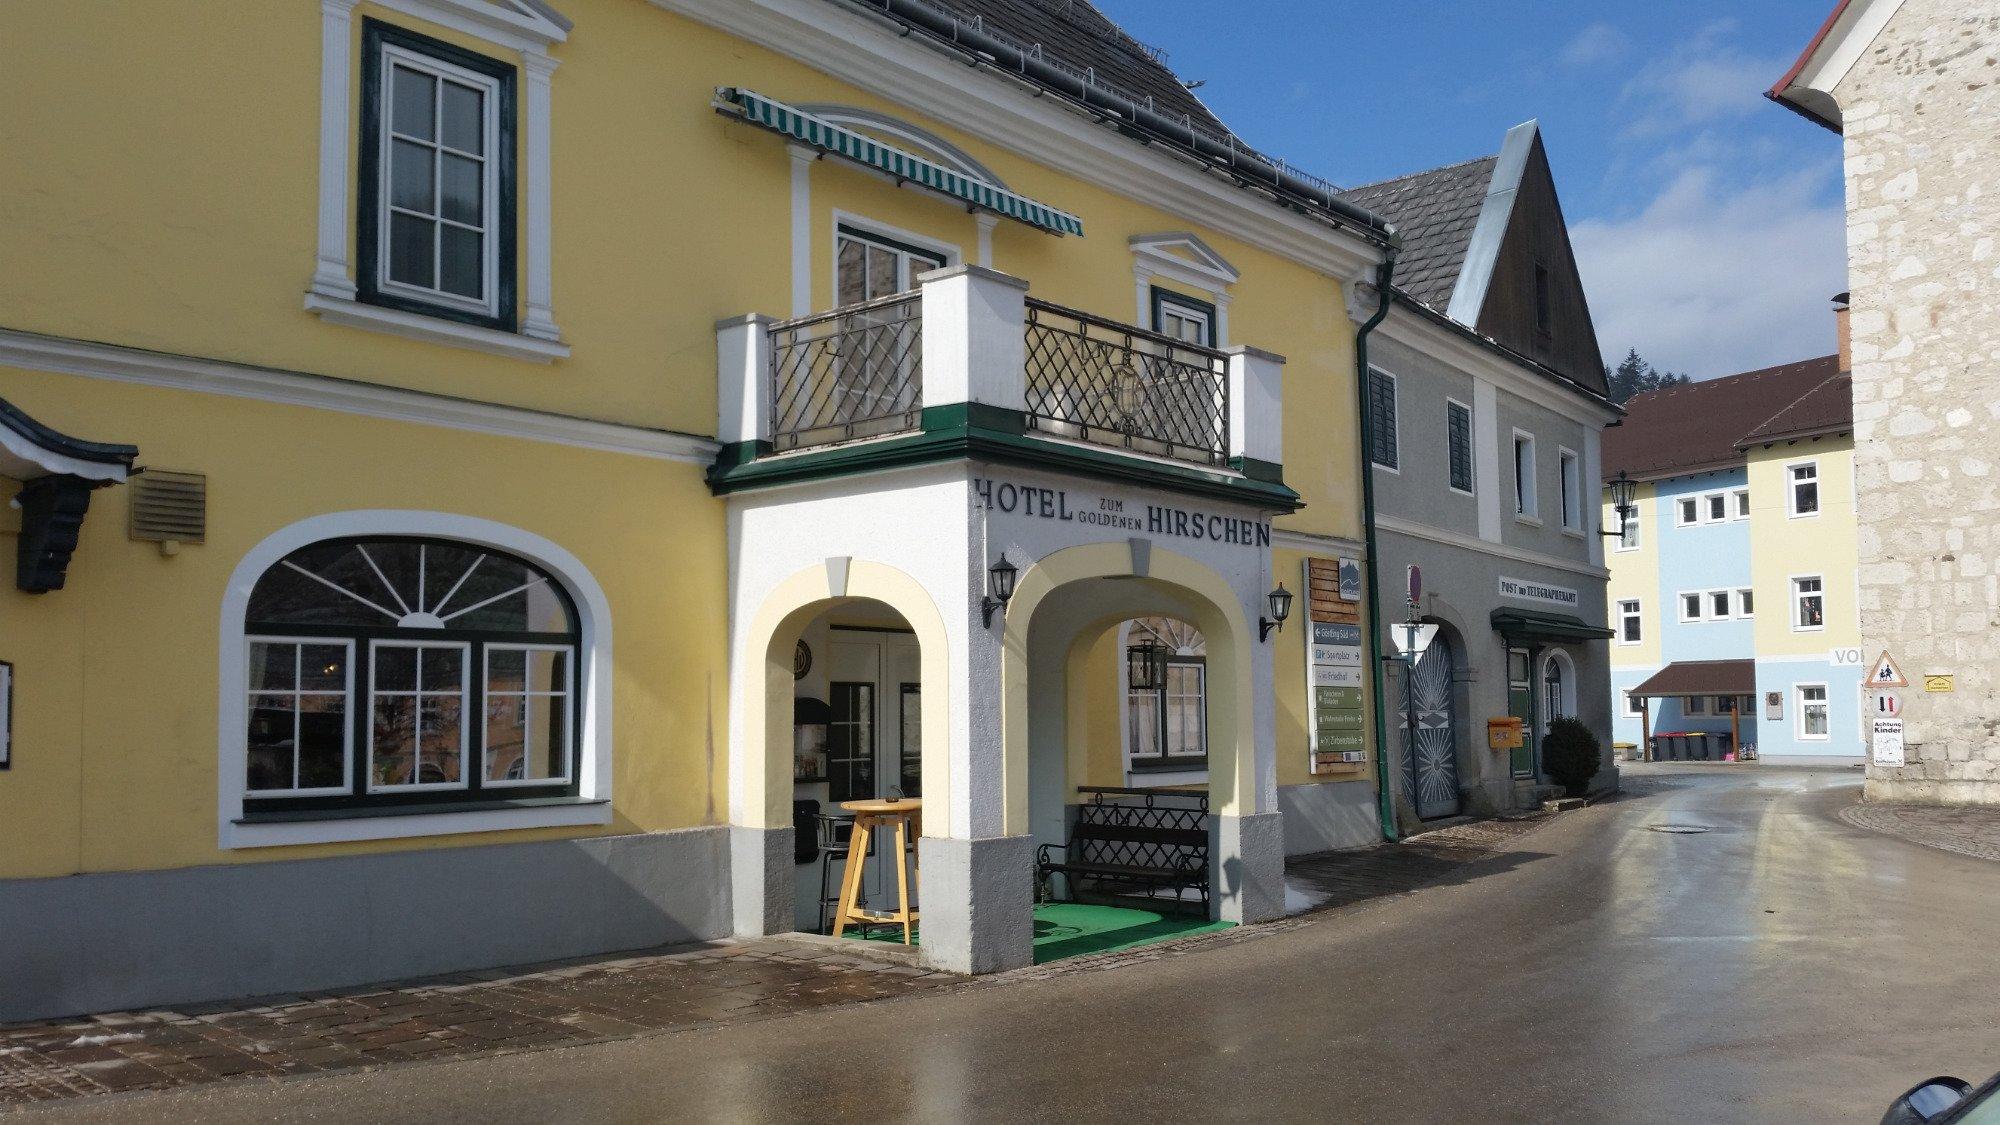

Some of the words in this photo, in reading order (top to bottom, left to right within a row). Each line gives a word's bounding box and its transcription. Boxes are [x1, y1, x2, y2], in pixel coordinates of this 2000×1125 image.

[974, 478, 1073, 521] HOTEL
[1100, 498, 1123, 513] ZUM
[1078, 511, 1142, 530] GOLDENEN
[1147, 505, 1270, 548] HIRSCHEN
[1501, 581, 1517, 594] POST
